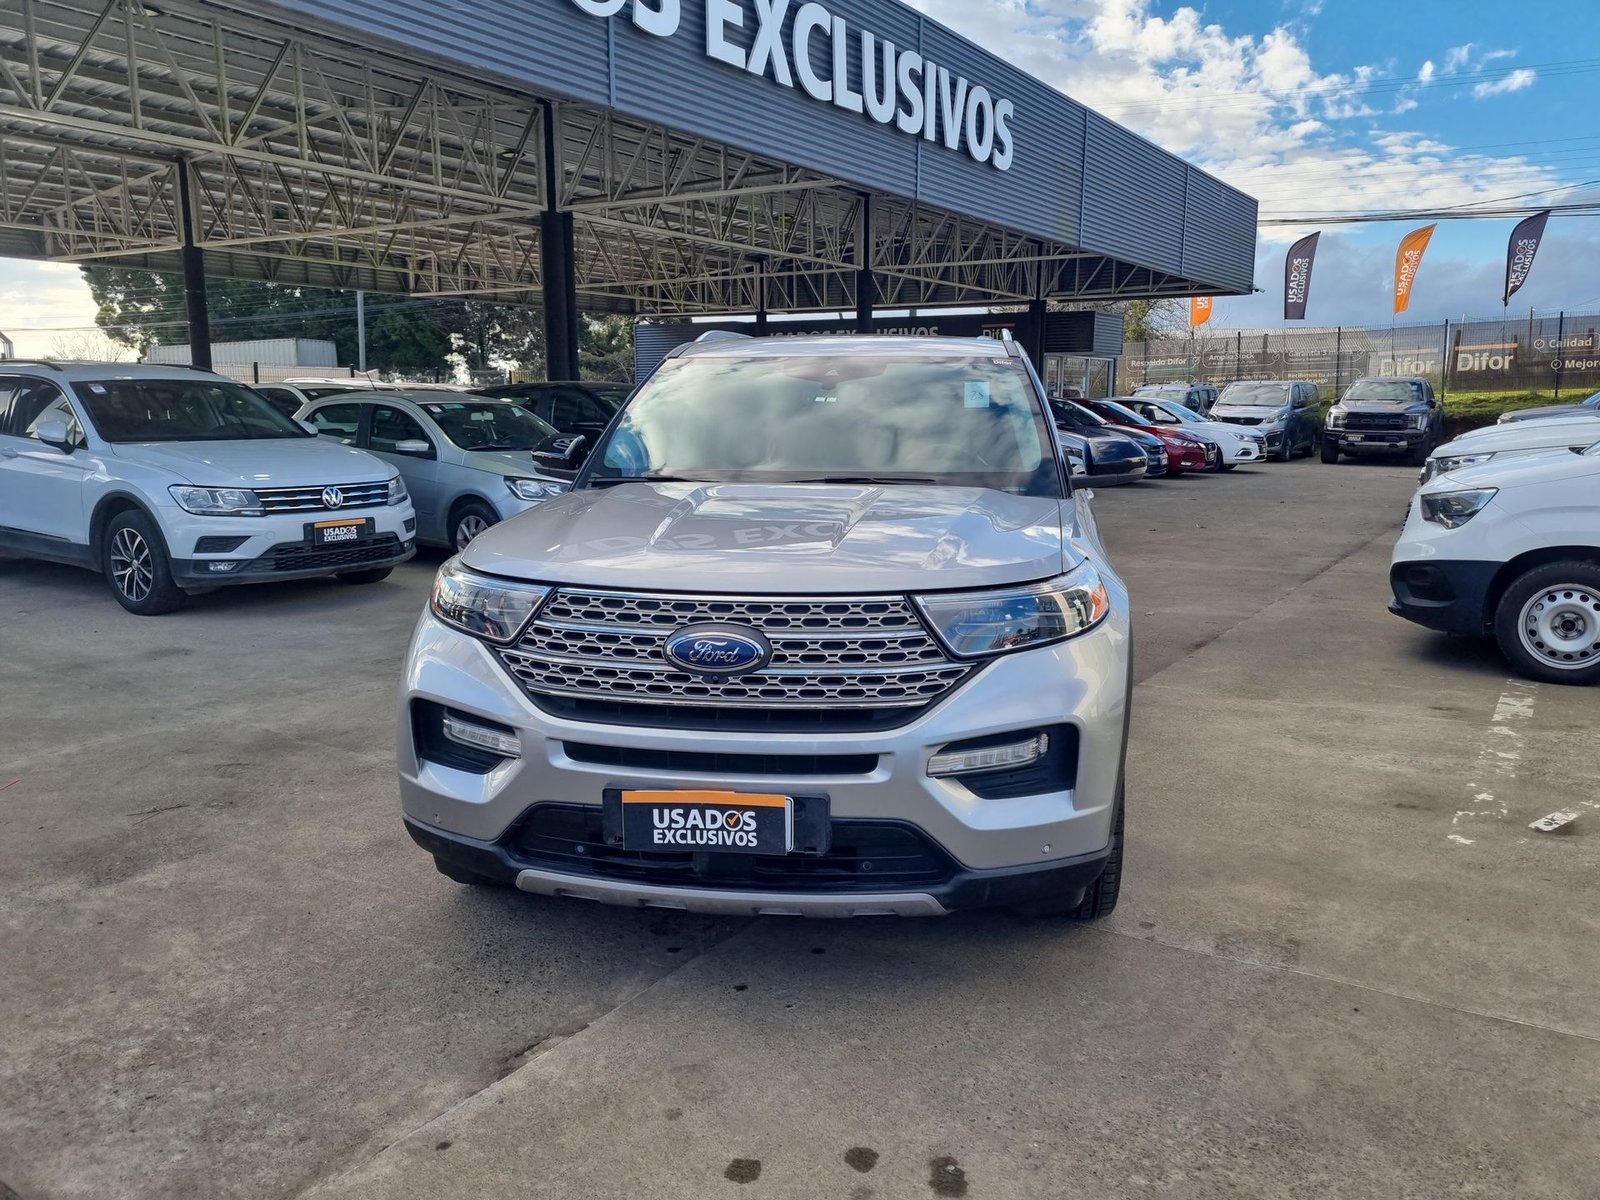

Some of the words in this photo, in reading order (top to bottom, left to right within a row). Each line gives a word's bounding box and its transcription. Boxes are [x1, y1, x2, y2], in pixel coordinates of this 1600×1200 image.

[706, 0, 1014, 171] EXCLUSIVOS
[1287, 258, 1302, 303] USADOS
[1296, 258, 1310, 303] EXCLUSIVOS
[1396, 250, 1414, 296] USADOS
[982, 328, 1013, 340] Dif
[1548, 336, 1592, 349] Calidad
[1131, 359, 1166, 368] Respaldo
[1167, 357, 1187, 366] Difor
[1379, 357, 1435, 376] Difor
[1456, 353, 1514, 372] Difor
[323, 526, 357, 536] USADOS
[324, 533, 358, 542] EXCLUSIVOS
[688, 640, 741, 663] Ford
[652, 808, 757, 831] USADOS
[653, 828, 758, 847] EXCLUSIVOS
